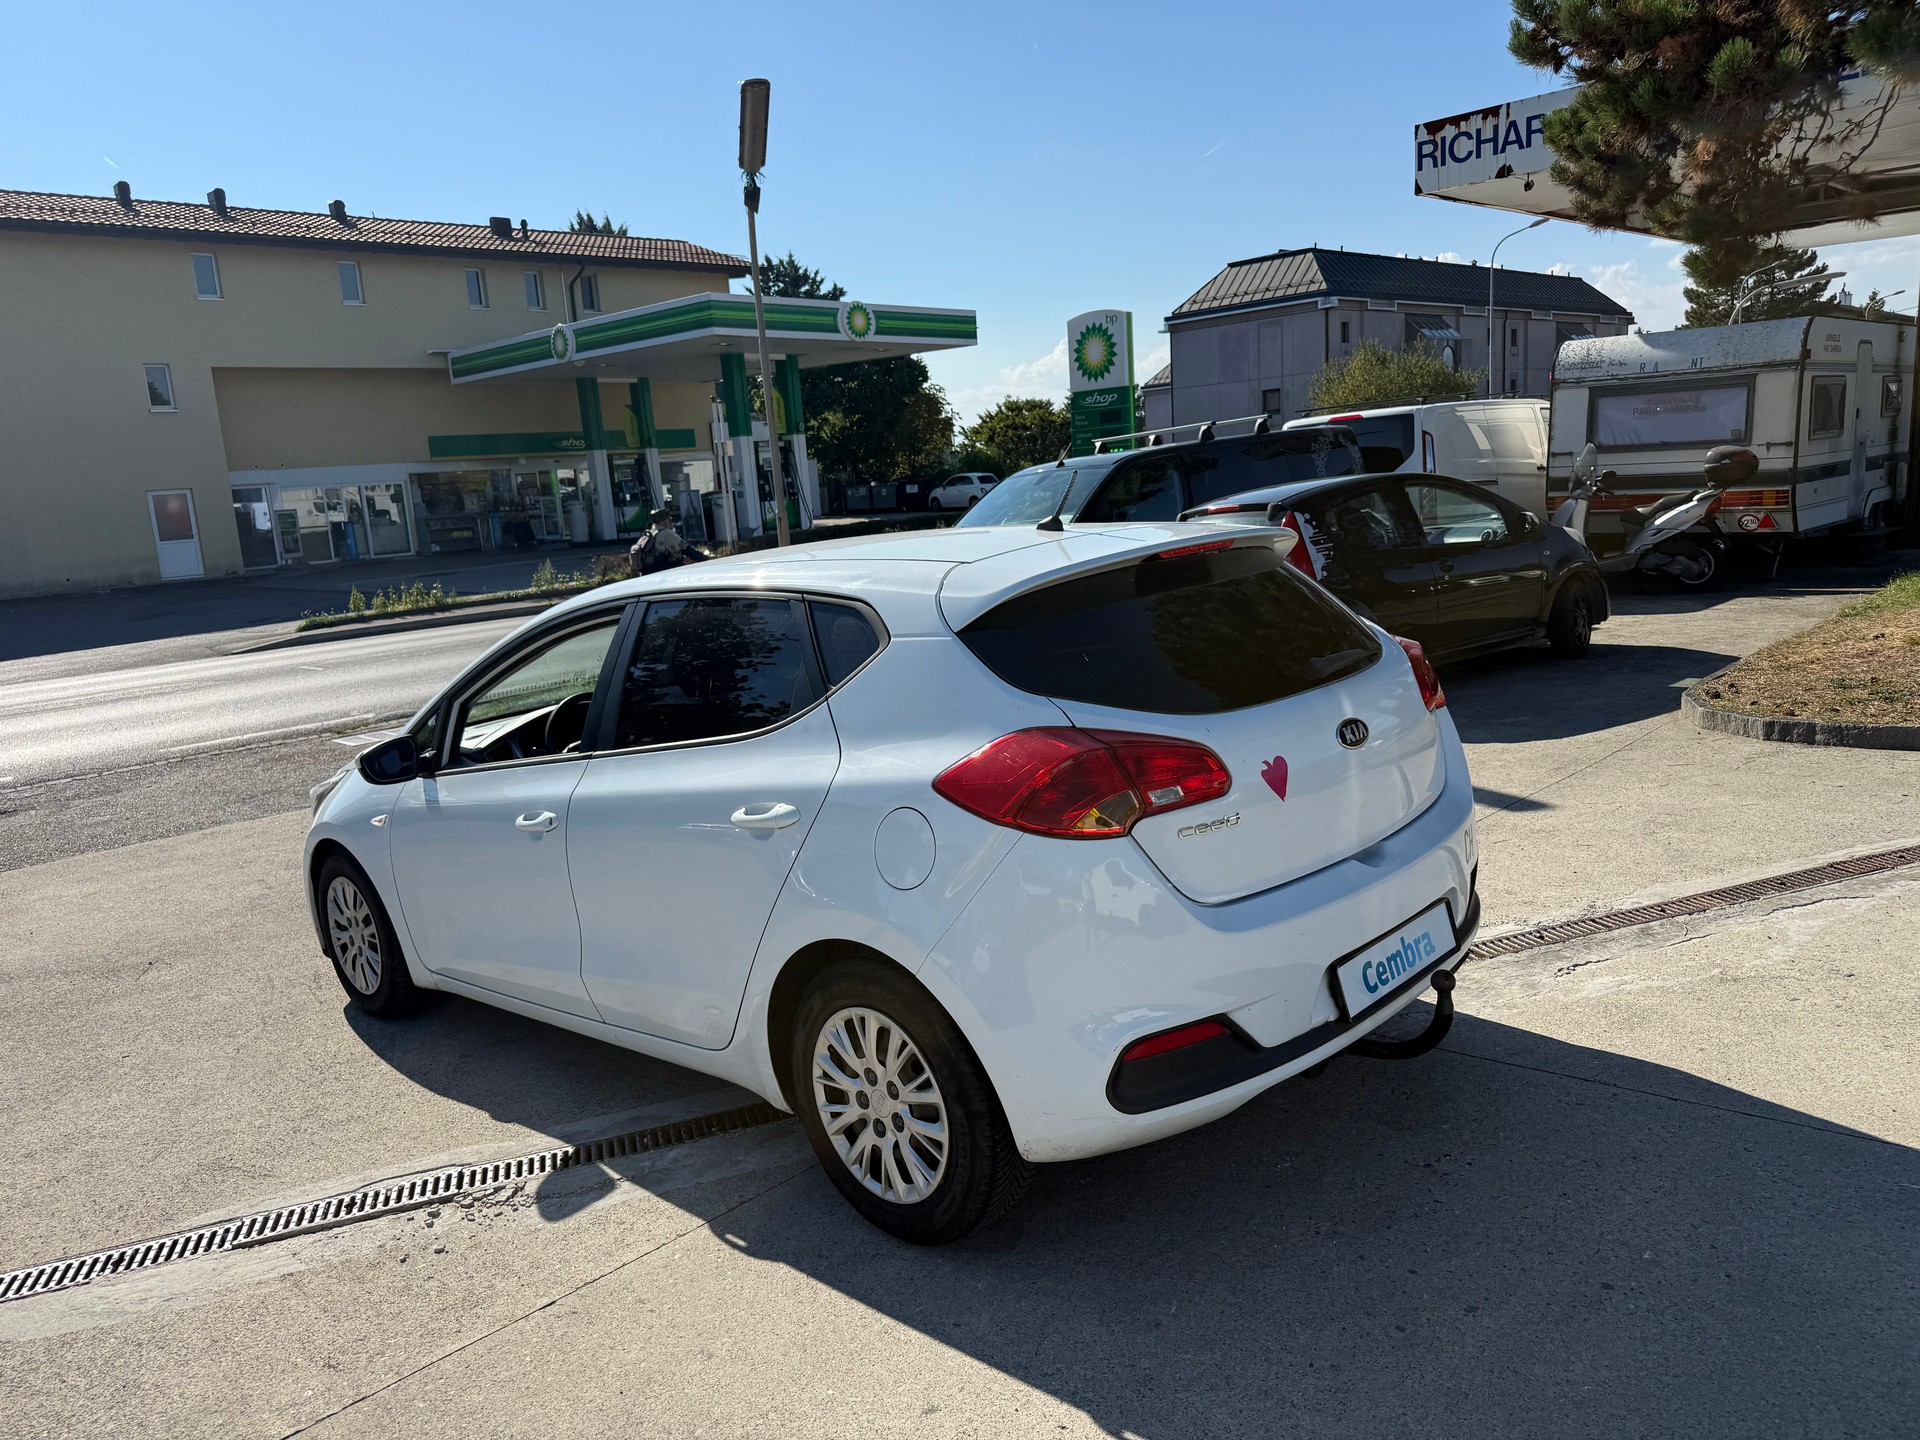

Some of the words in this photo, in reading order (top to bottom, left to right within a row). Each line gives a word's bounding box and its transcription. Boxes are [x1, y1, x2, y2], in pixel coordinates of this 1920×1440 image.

[1105, 313, 1118, 326] bp
[1085, 392, 1118, 406] shop
[561, 436, 586, 449] sho
[1341, 721, 1367, 744] KIA
[1463, 823, 1474, 865] CH
[1362, 931, 1435, 993] Cembra
